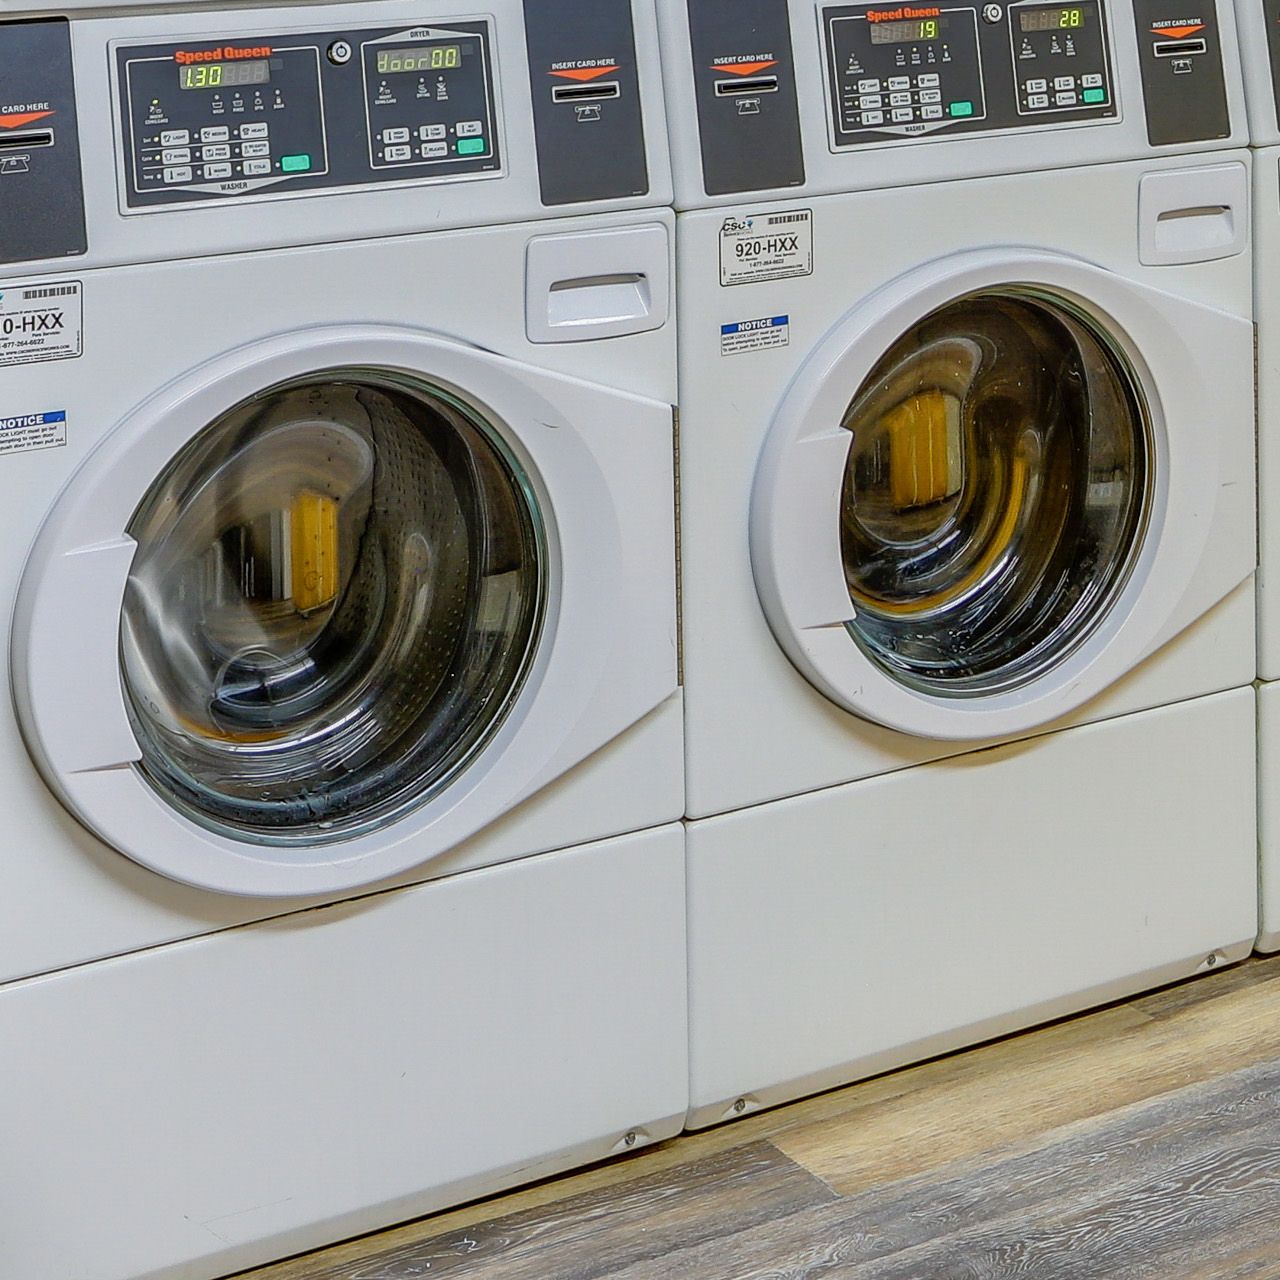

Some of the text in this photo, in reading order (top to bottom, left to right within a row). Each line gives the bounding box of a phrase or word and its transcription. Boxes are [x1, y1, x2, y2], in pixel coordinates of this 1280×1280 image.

[866, 7, 940, 22] Speed Queen
[1059, 10, 1080, 27] 28
[410, 30, 430, 38] DRYER
[920, 21, 936, 38] 19
[175, 47, 272, 64] Speed Queen
[713, 53, 773, 65] INSERT CARD HERE
[577, 60, 596, 69] CARD
[597, 58, 615, 67] HERE
[186, 66, 222, 87] 1.30
[2, 104, 25, 114] CARD
[26, 102, 49, 112] HERE
[220, 182, 248, 190] WASHER
[736, 236, 798, 257] 920-HXX
[738, 319, 773, 332] NOTICE
